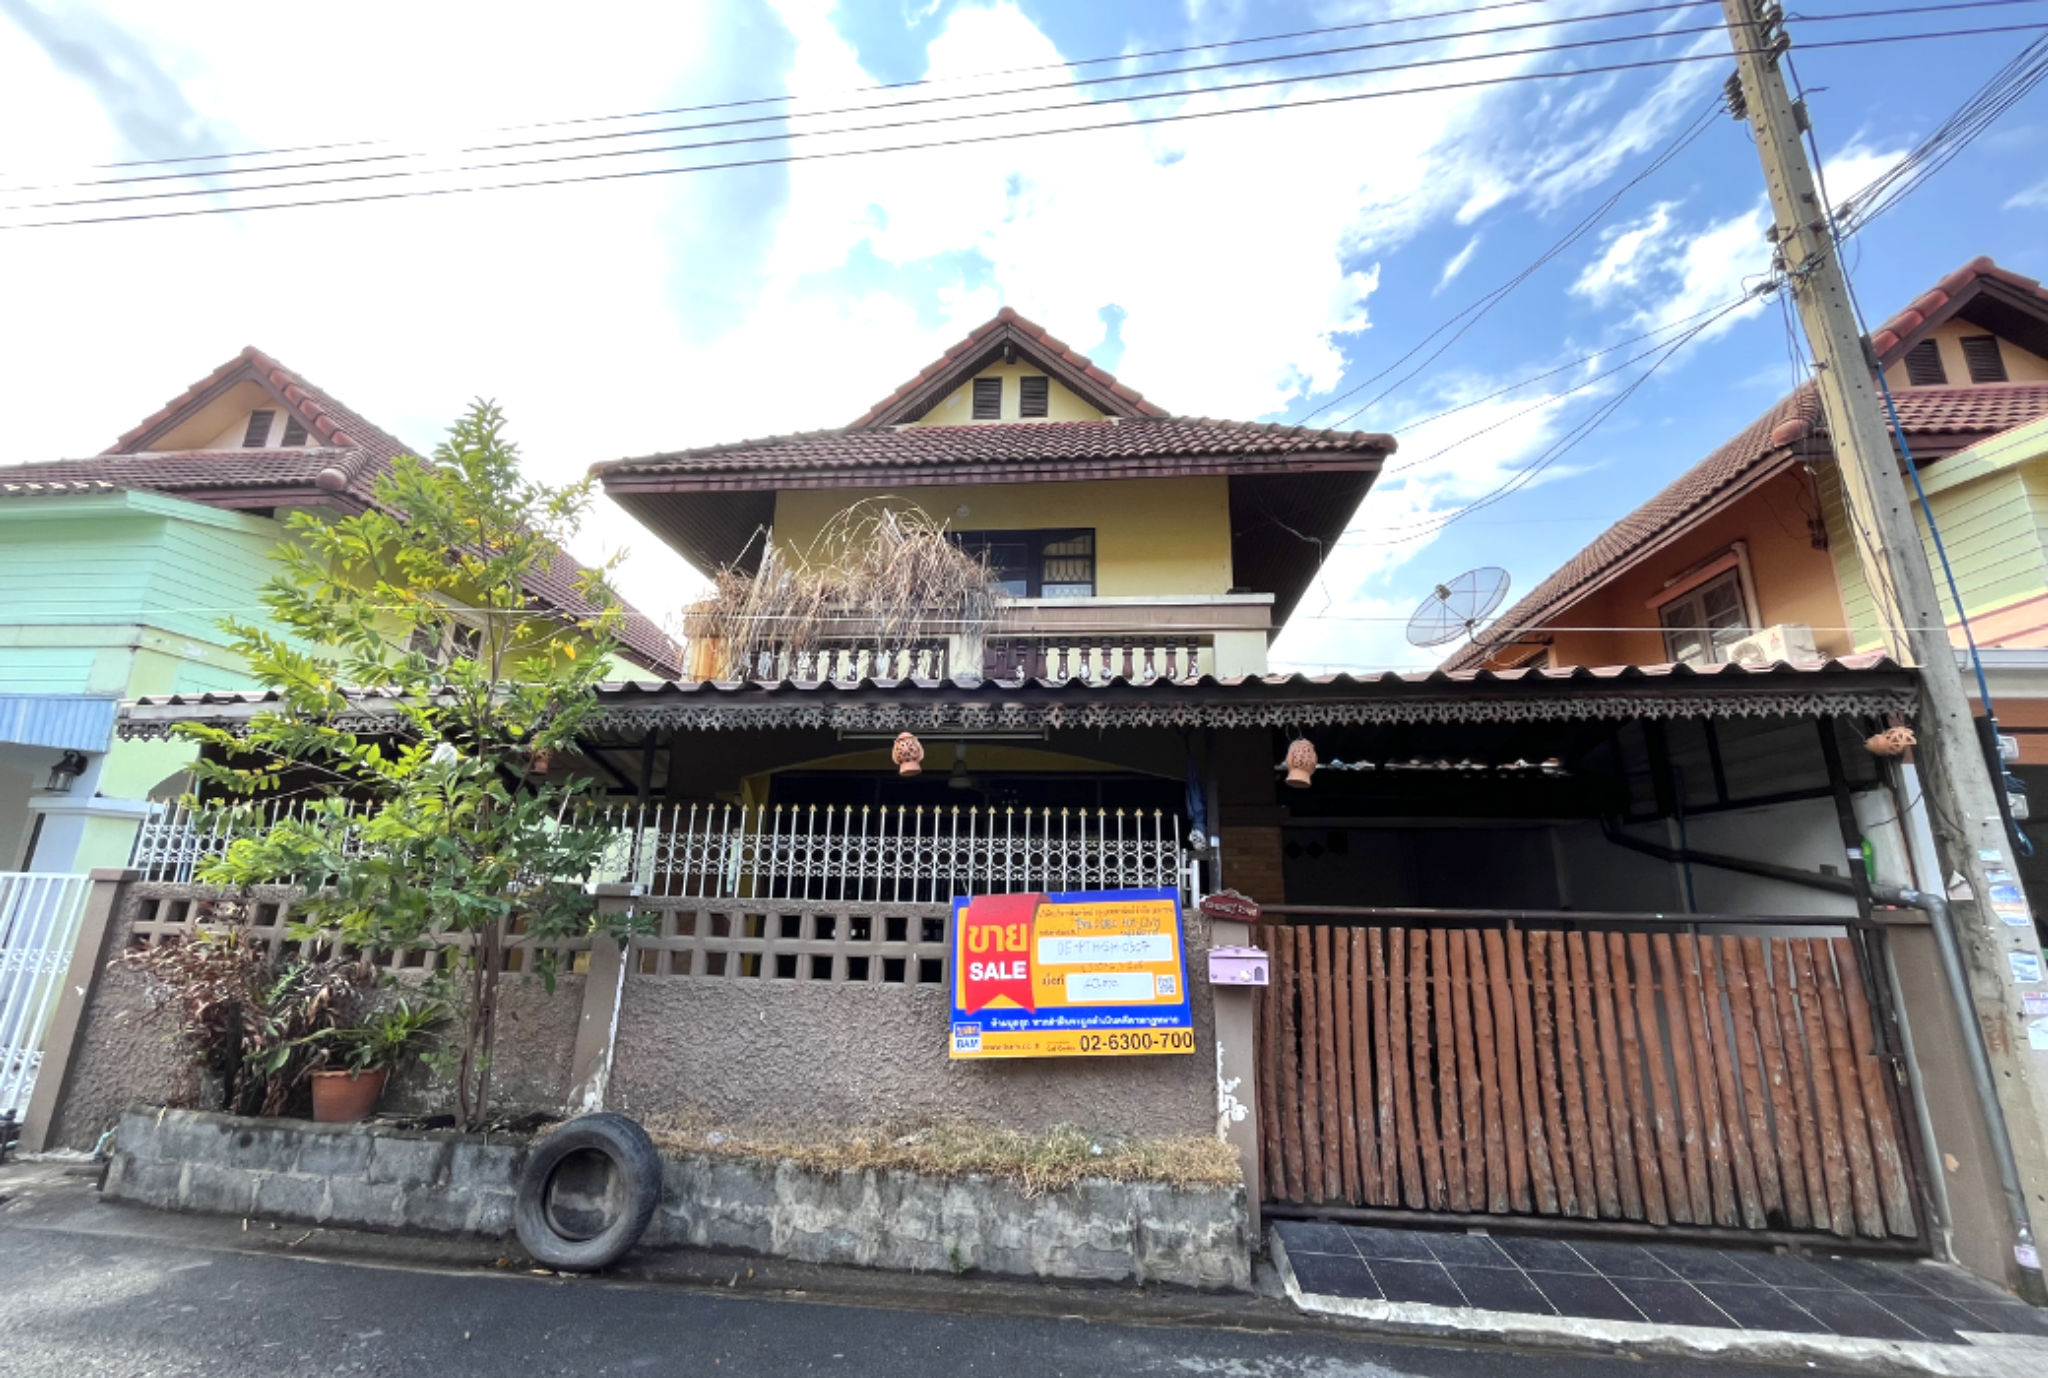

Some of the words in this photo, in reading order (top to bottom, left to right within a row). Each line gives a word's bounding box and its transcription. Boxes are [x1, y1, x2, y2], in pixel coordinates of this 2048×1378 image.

[969, 924, 1027, 953] ขาย
[969, 961, 1027, 980] SALE
[1080, 1032, 1193, 1052] 02-6300-700
